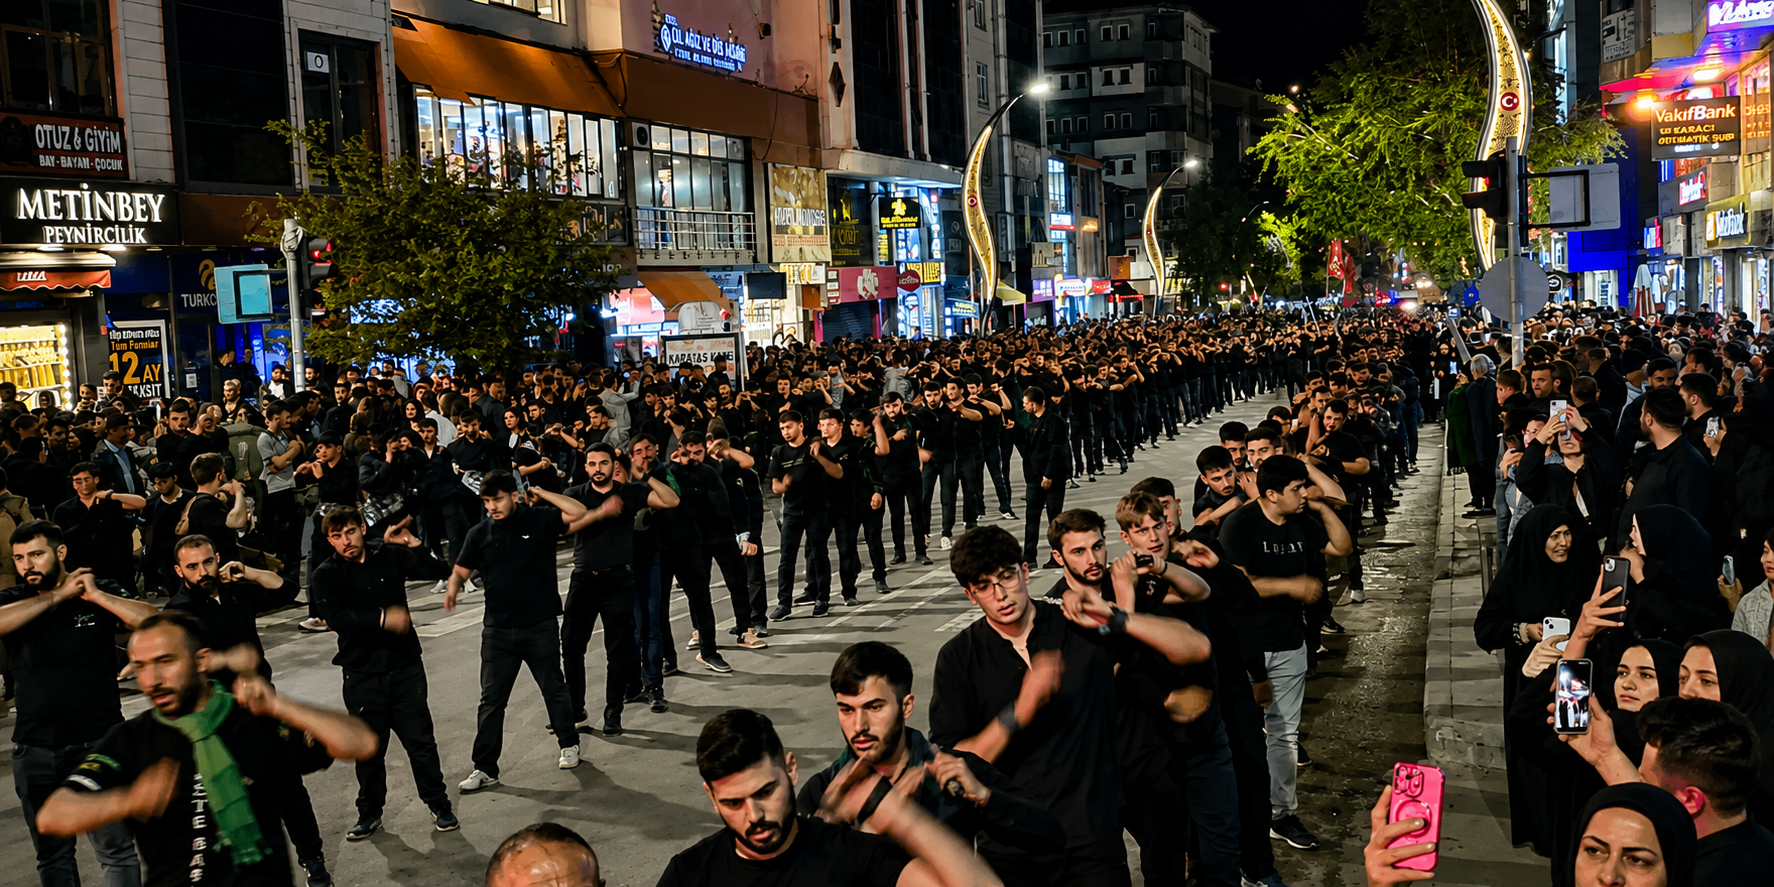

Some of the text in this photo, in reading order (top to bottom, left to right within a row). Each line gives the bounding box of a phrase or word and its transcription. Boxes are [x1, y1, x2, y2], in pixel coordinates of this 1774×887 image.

[35, 124, 121, 154] OTUZ & GİYİM
[39, 155, 55, 167] BAY
[95, 159, 123, 172] ÇOCUK
[16, 182, 165, 222] METİNBEY
[42, 223, 147, 244] PEYNİRCİLİK
[181, 293, 217, 308] TURKC
[109, 351, 161, 385] 12 AY
